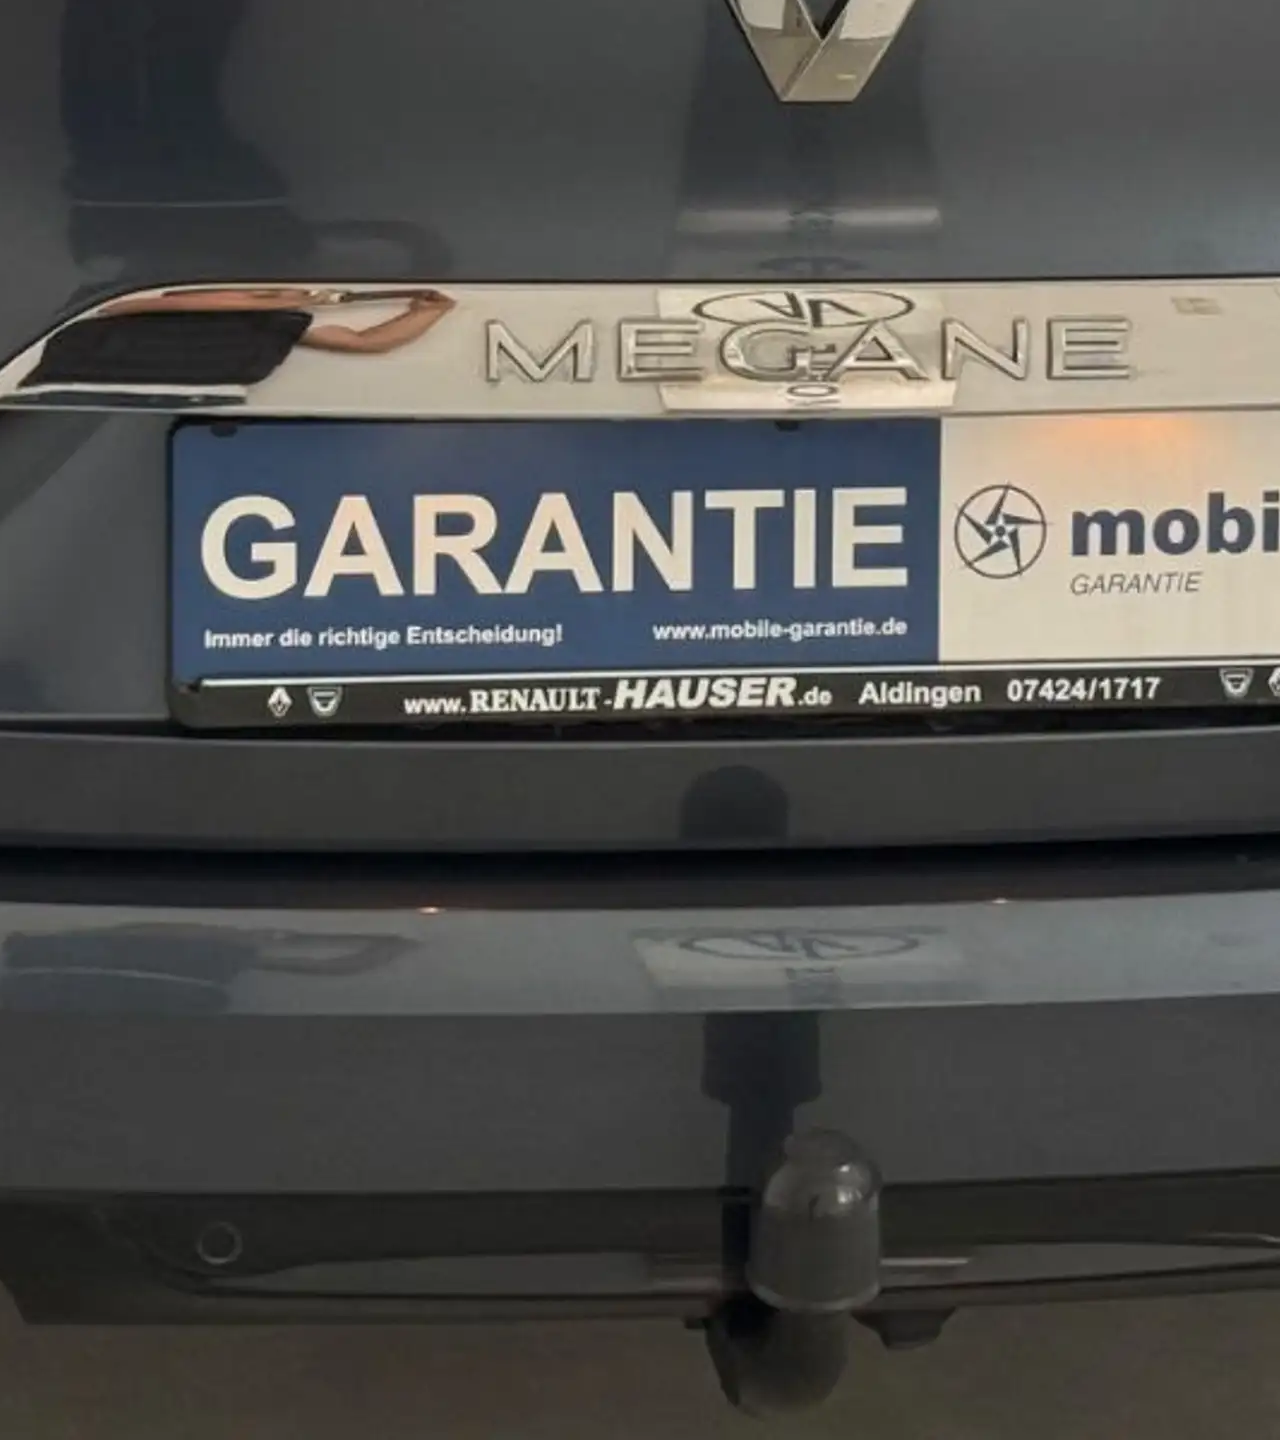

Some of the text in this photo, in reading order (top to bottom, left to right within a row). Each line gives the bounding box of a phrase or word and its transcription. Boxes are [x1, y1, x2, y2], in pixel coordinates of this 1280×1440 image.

[484, 317, 1133, 384] MEGANE
[200, 487, 909, 599] GARANTIE
[1070, 571, 1205, 596] GARANTIE
[204, 624, 564, 650] Immer die richtige Entscheidung!
[652, 617, 908, 642] www.mobile-garantie.de
[858, 679, 982, 708] Aldingen
[1007, 677, 1161, 702] 07424/1717
